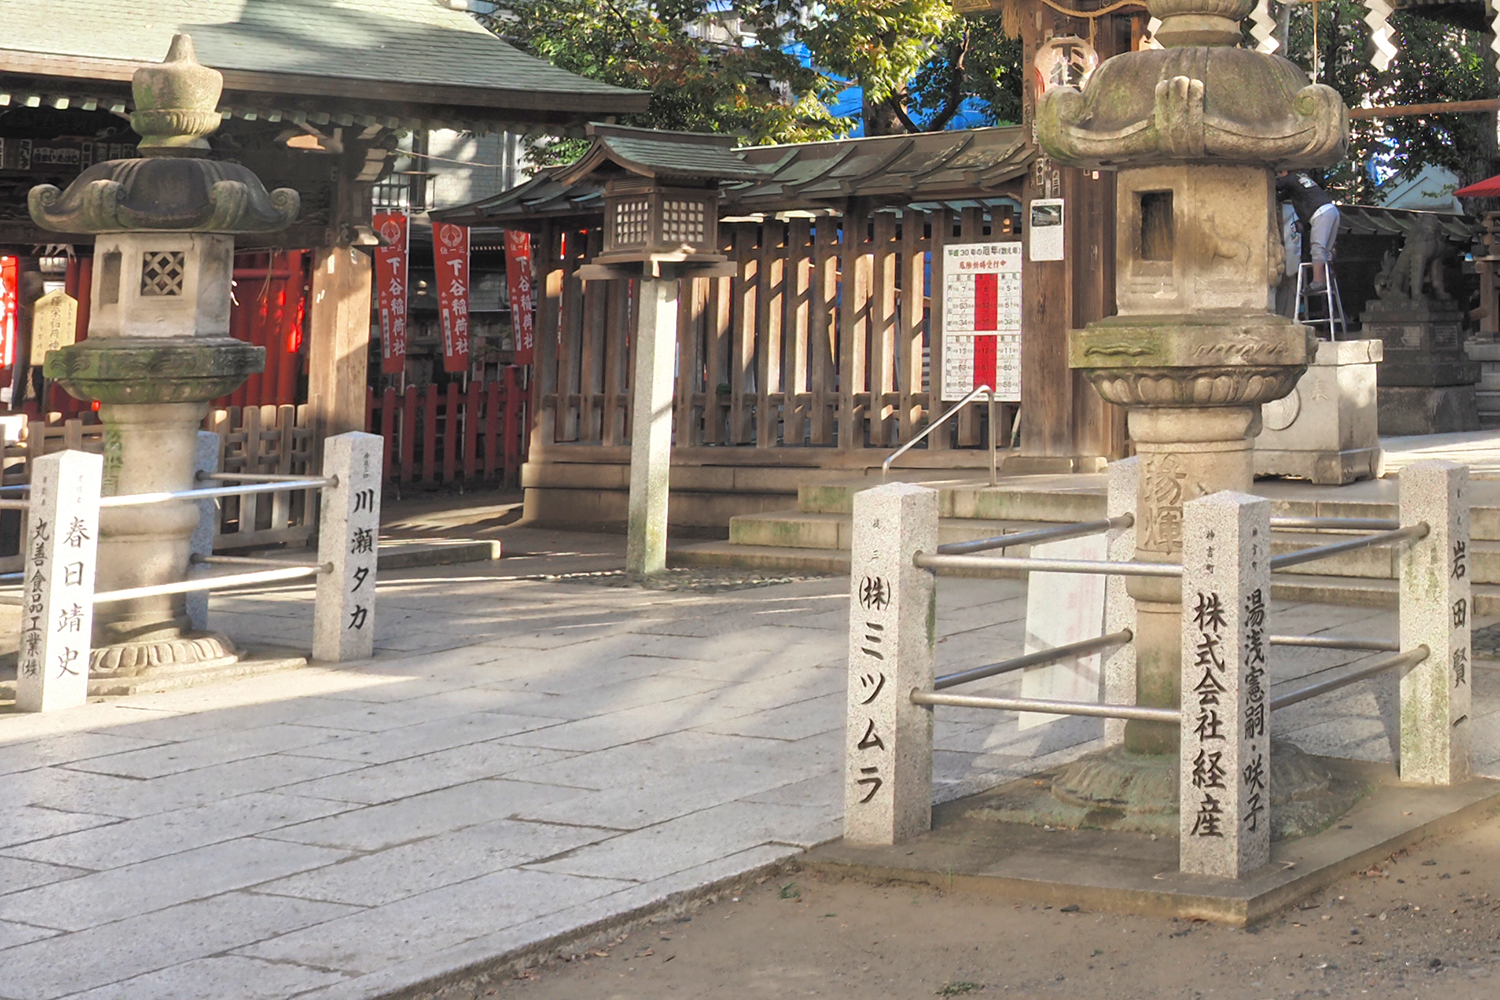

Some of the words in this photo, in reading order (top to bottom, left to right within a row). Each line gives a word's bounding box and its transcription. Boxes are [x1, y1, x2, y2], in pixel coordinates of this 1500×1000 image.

[386, 257, 406, 356] 下谷稲荷社
[446, 258, 469, 355] 下谷稲荷社
[515, 255, 533, 350] 下谷稲荷社
[57, 516, 90, 678] 春日靖史
[348, 488, 374, 630] 川瀬タカ
[1451, 541, 1468, 727] 岩田賢一
[858, 576, 892, 803] (株)ミツムラ
[1190, 592, 1228, 838] 株式会社経産
